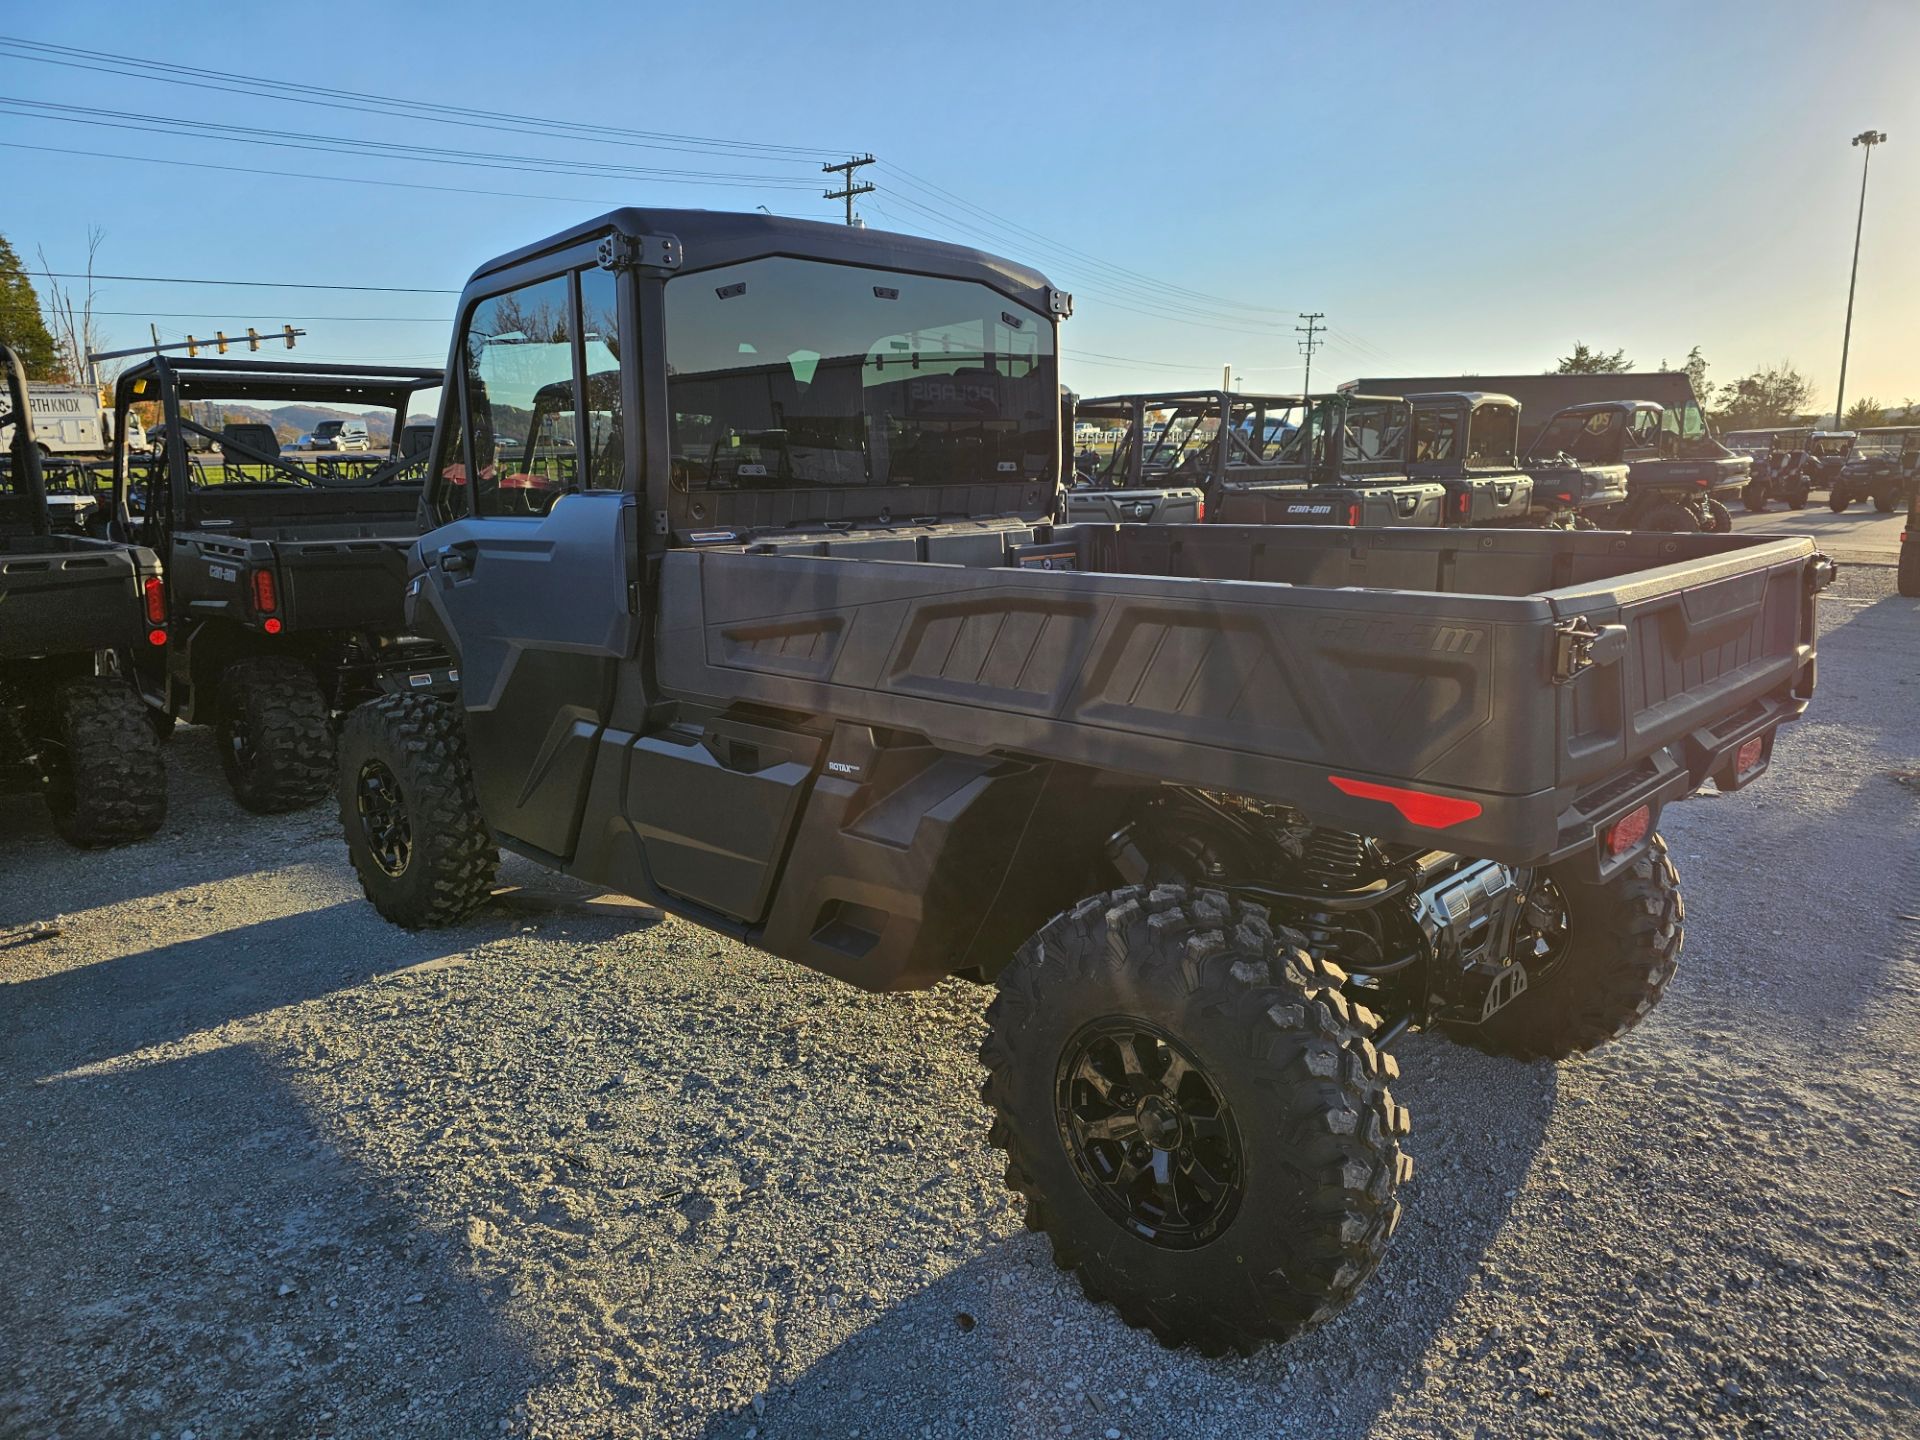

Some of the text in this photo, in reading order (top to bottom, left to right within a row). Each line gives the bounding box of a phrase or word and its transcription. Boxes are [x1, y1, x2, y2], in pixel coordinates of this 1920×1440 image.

[30, 398, 81, 412] RTH KNOX
[1287, 505, 1332, 514] can-am
[829, 762, 851, 773] ROTAX
